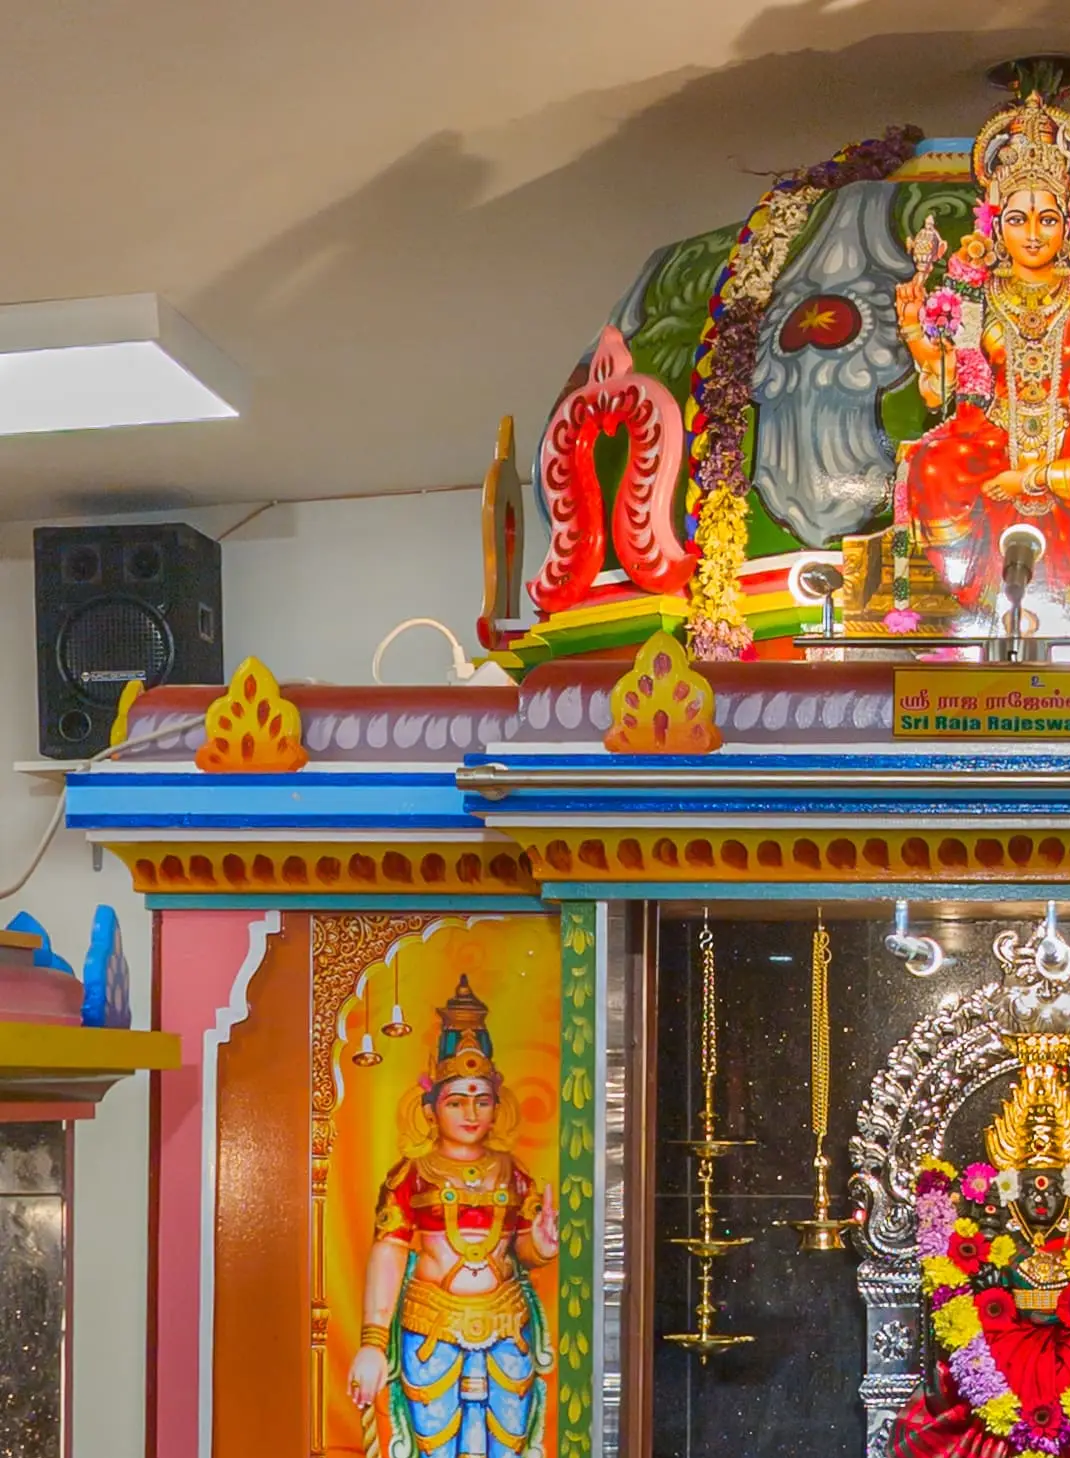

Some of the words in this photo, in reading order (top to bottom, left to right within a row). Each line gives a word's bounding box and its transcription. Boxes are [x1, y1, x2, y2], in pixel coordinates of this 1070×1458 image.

[937, 695, 979, 711] ராஜ
[901, 715, 929, 730] Sri
[935, 715, 981, 731] Raja
